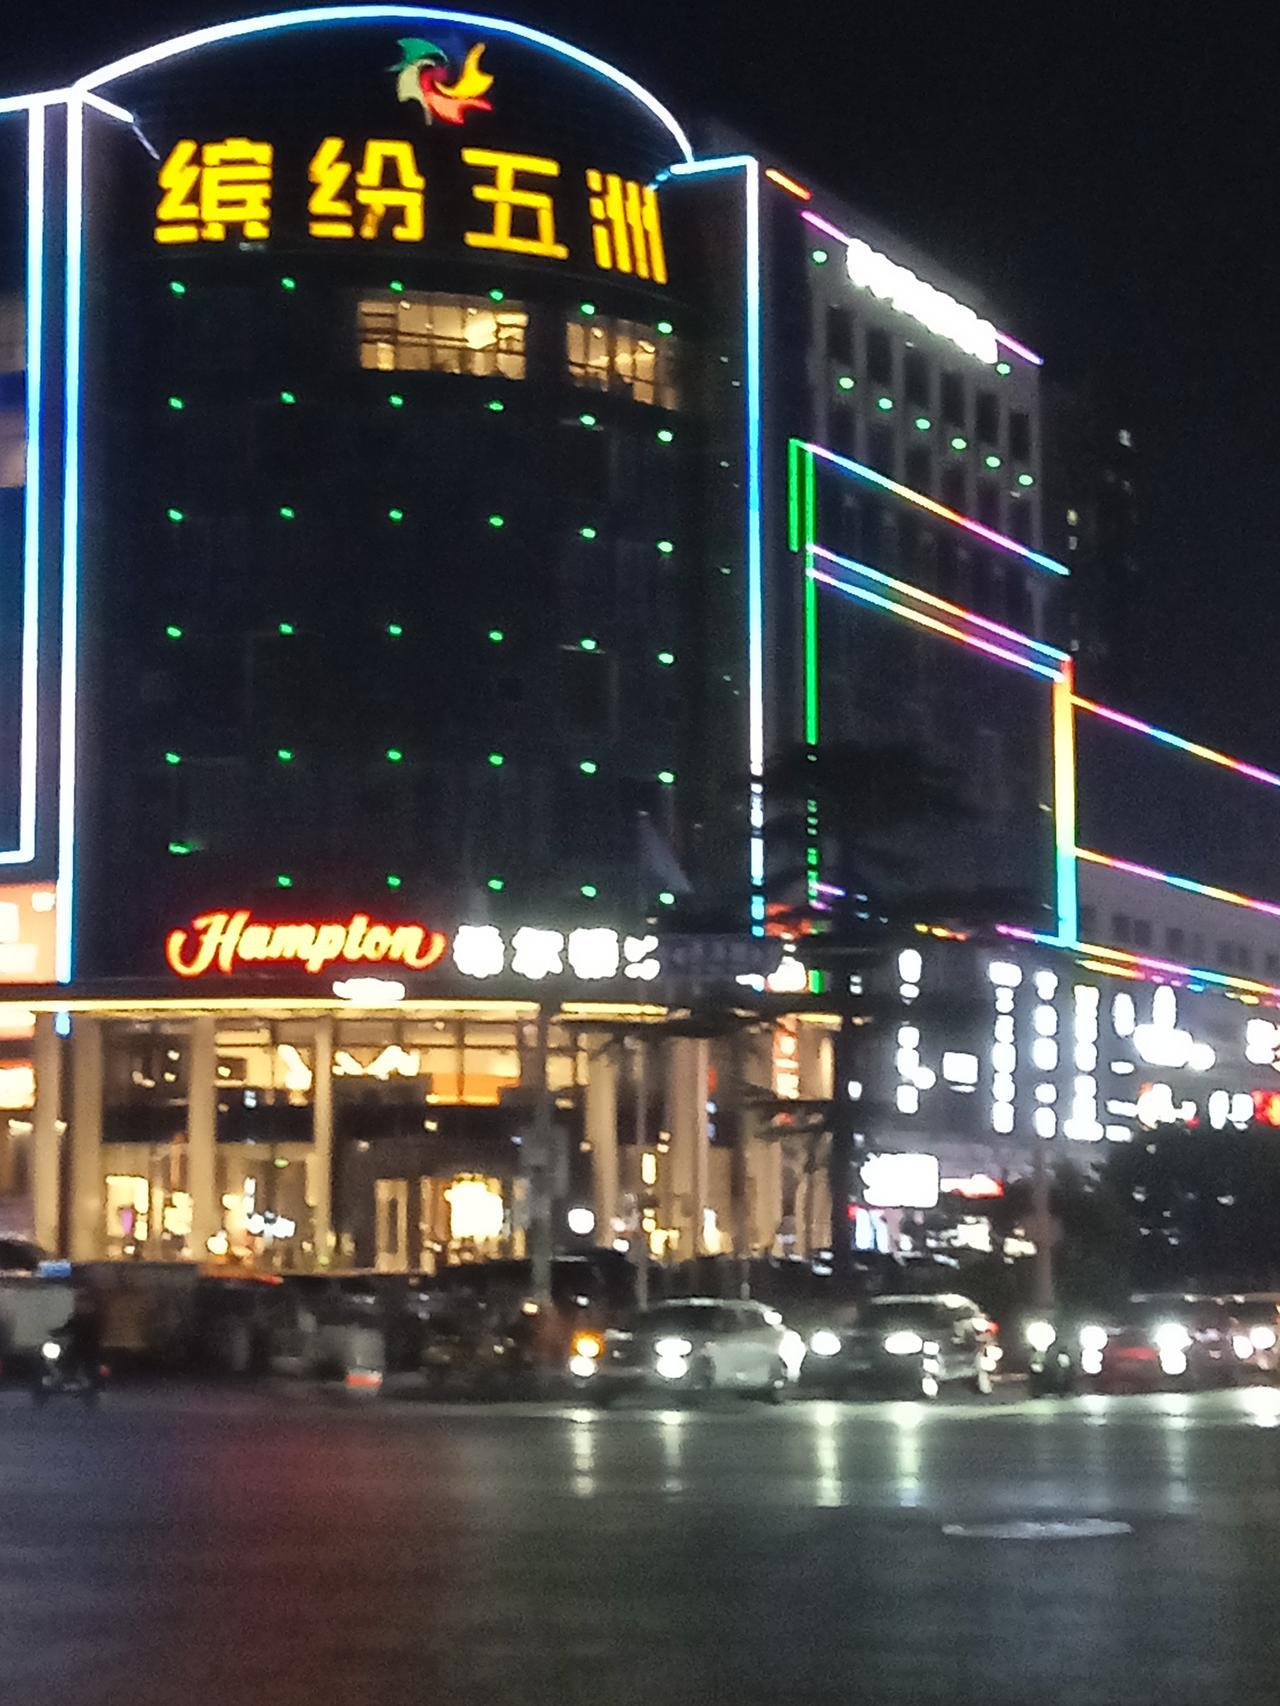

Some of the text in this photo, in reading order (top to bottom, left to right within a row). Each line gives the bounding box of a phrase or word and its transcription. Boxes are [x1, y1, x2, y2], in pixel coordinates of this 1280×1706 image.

[154, 137, 668, 285] 缤纷五洲
[166, 909, 447, 977] Hampton
